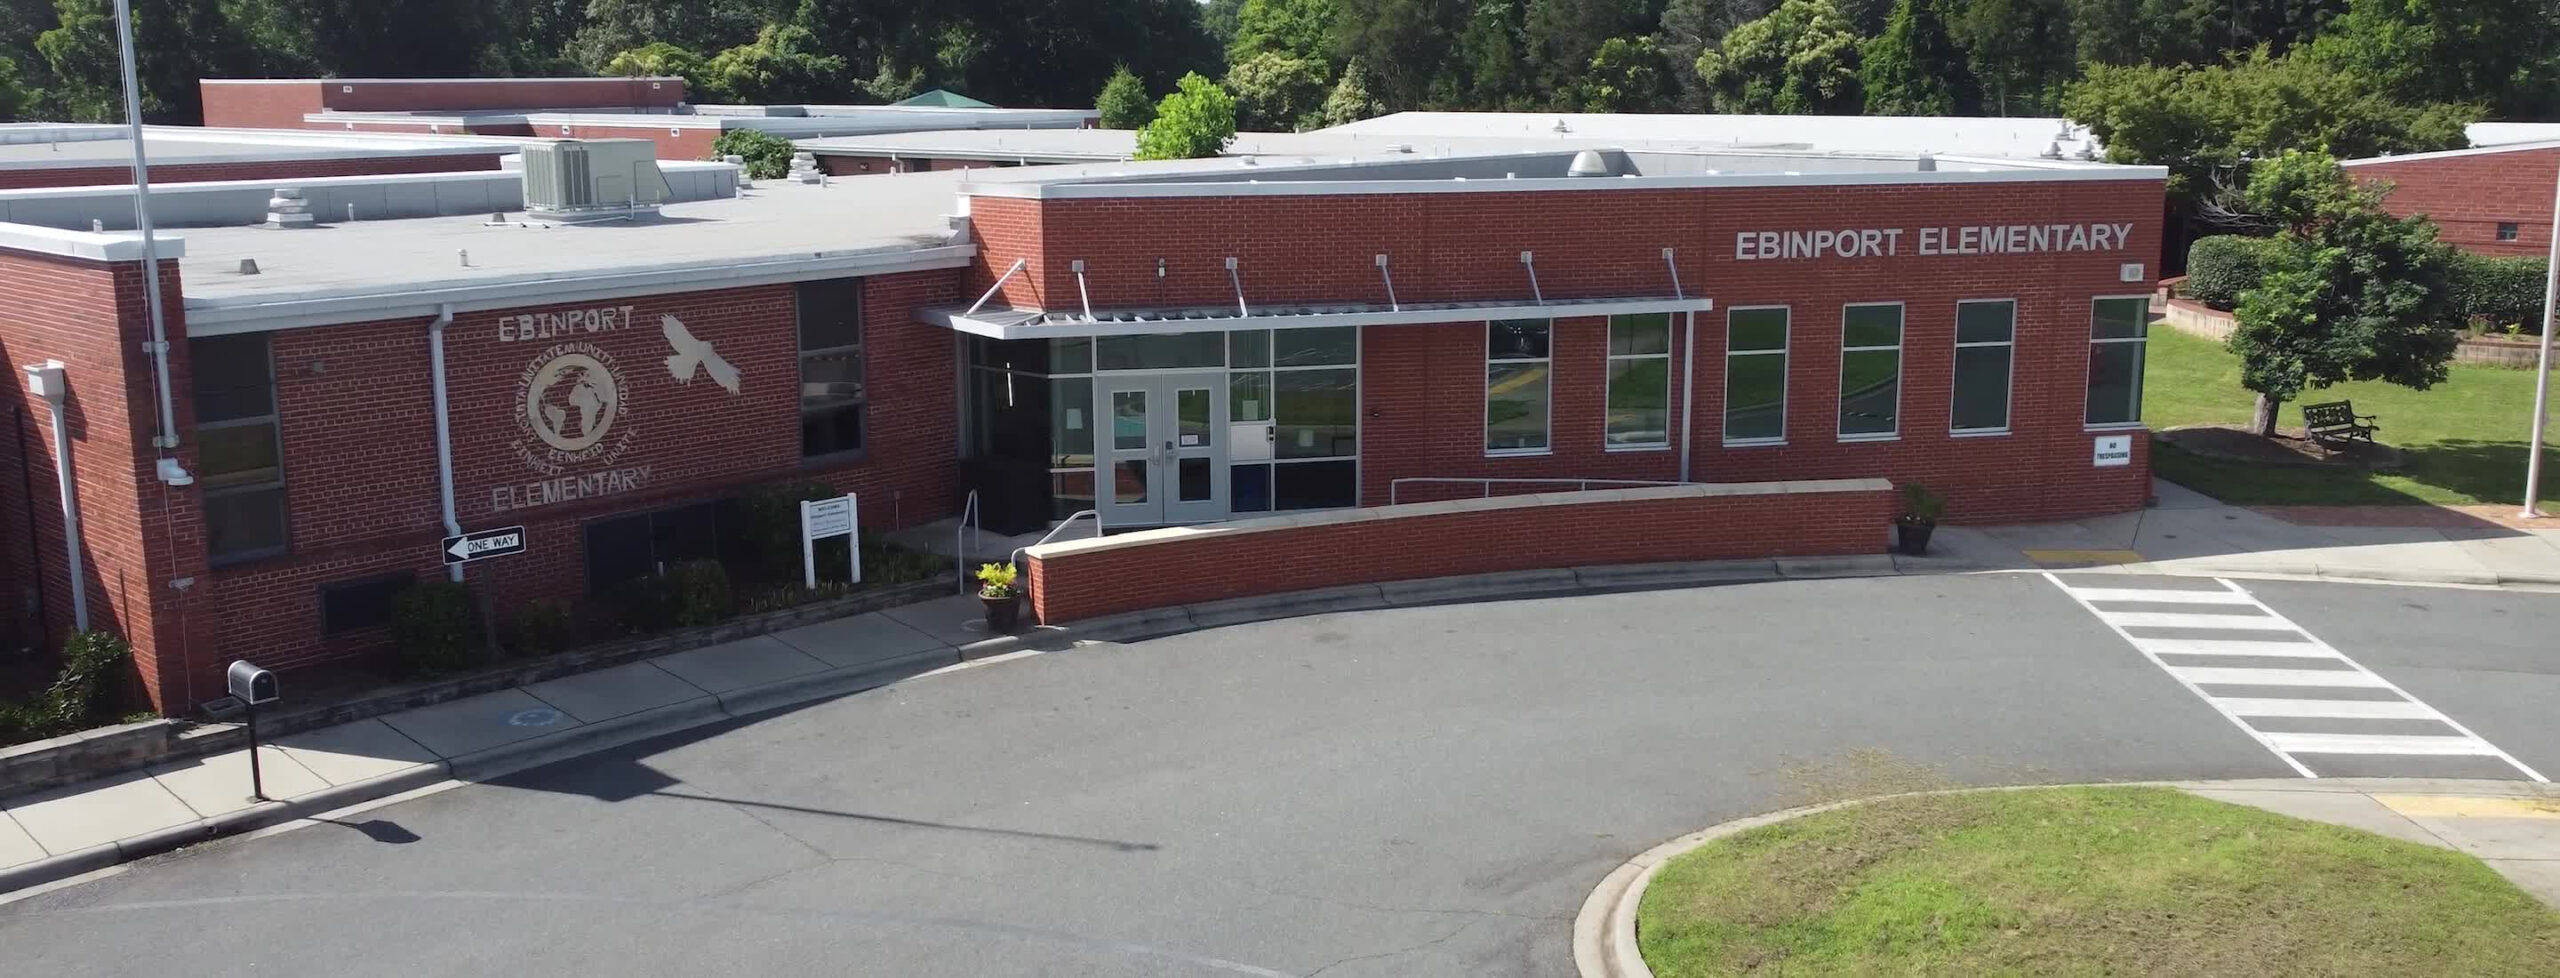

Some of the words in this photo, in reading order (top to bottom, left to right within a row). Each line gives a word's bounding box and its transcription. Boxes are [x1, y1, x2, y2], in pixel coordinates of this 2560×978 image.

[1736, 228, 1903, 260] EBINPORT
[1919, 223, 2134, 255] ELEMENTARY
[499, 305, 634, 342] EBINPORT
[492, 465, 651, 512] ELEMENTARY
[467, 540, 489, 552] ONE
[493, 535, 515, 547] WAY
